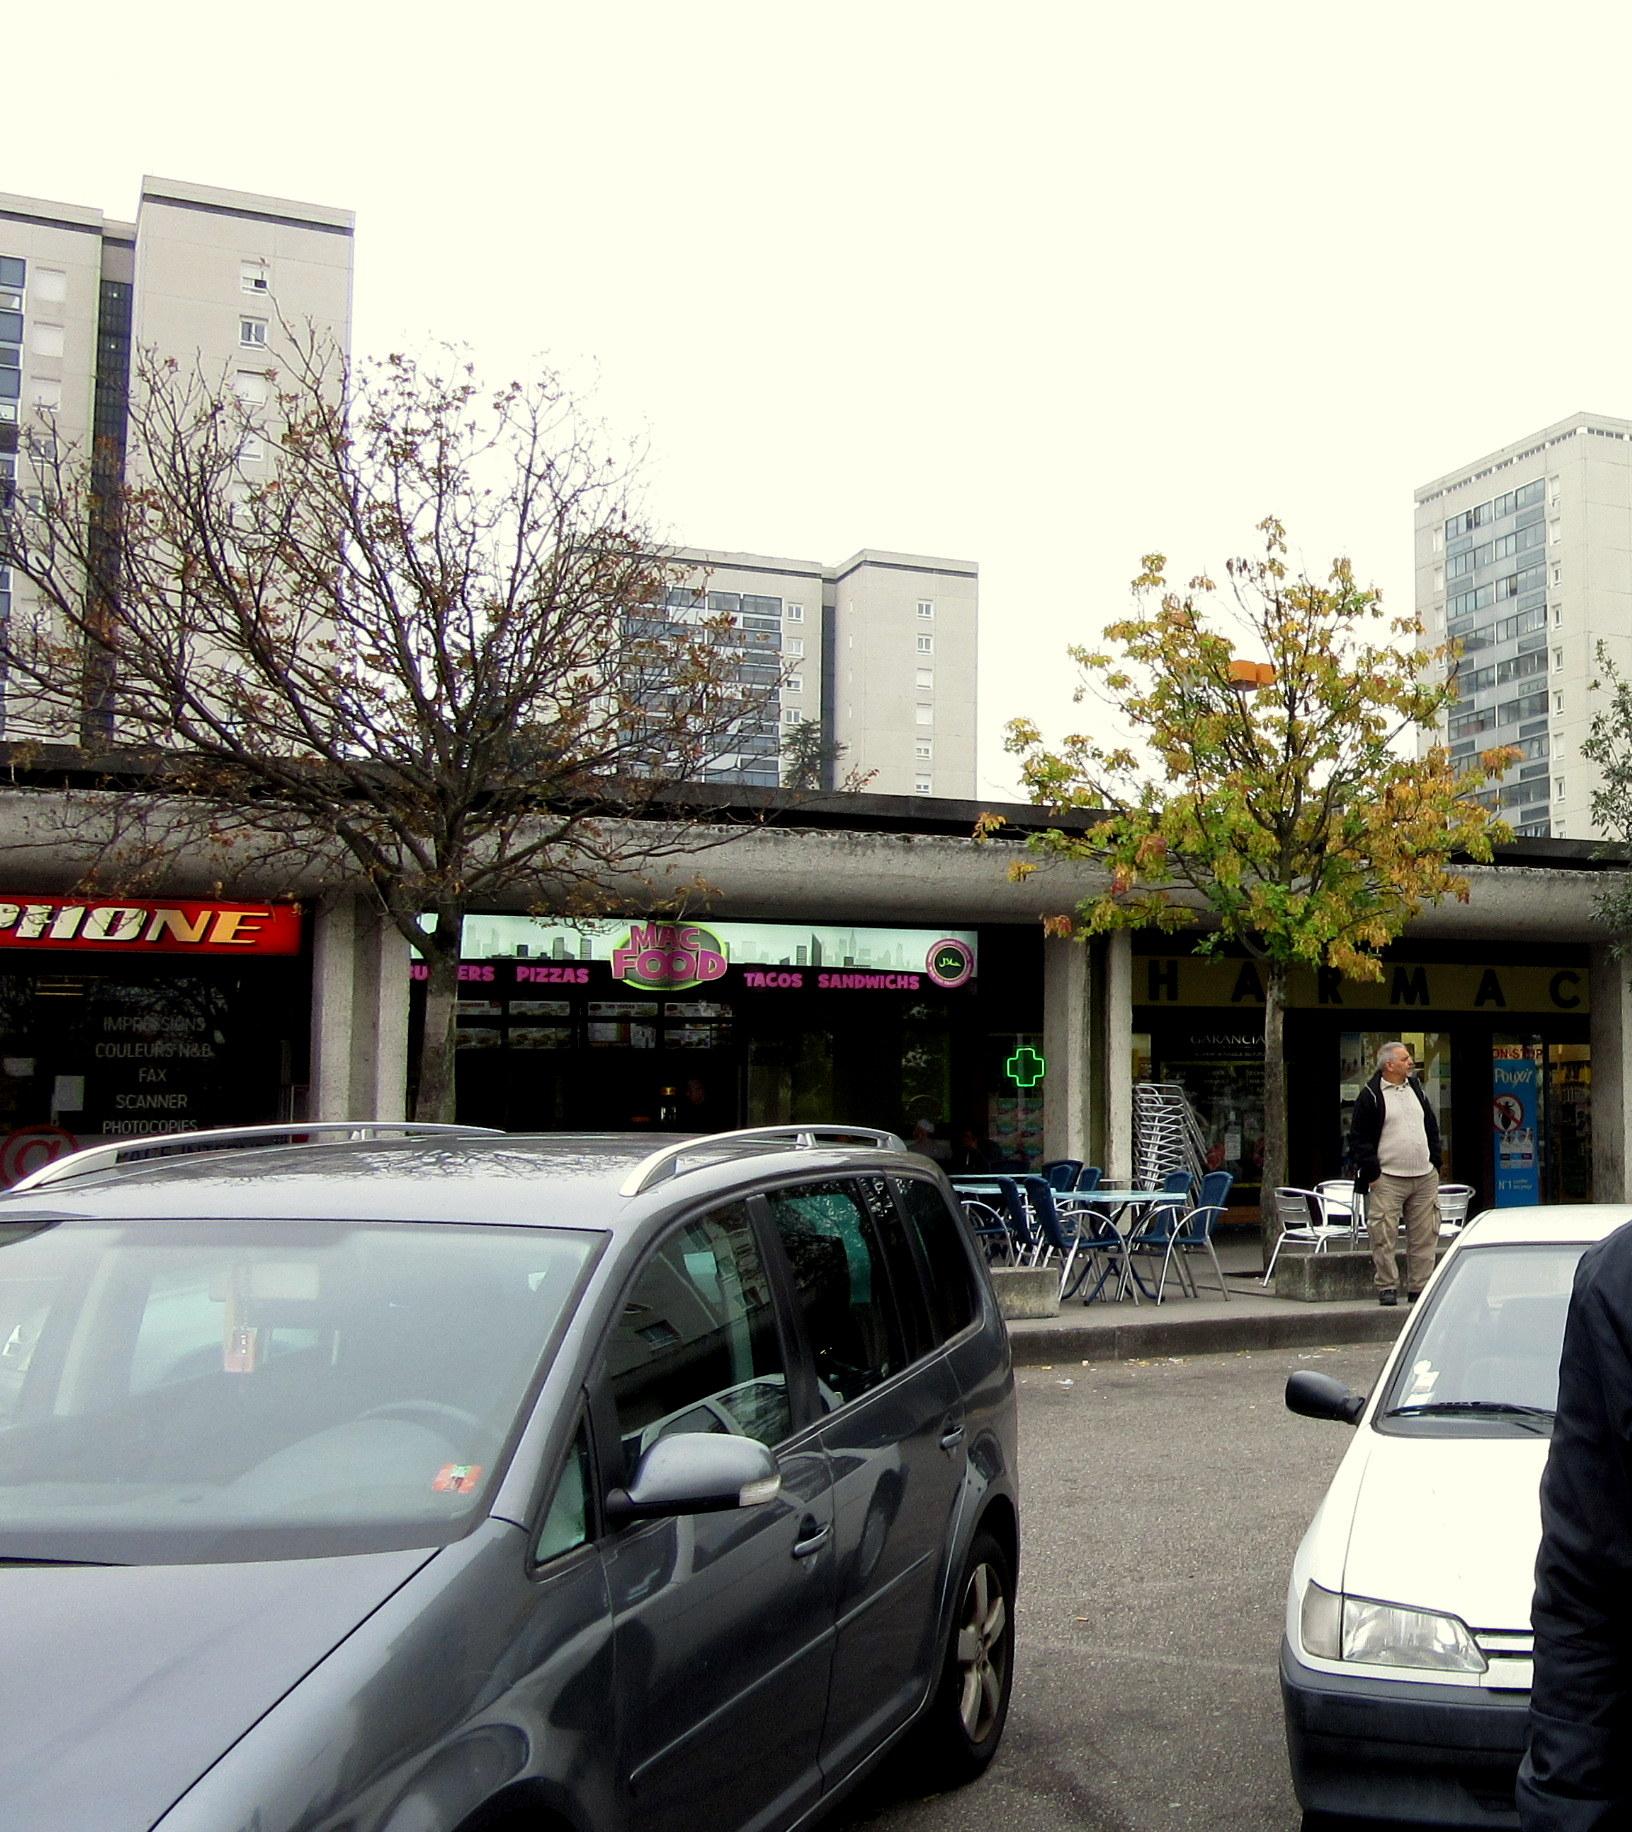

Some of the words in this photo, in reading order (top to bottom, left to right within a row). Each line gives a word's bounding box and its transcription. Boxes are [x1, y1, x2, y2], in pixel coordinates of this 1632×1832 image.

[630, 920, 701, 952] MAC
[612, 948, 728, 981] FOOD
[410, 964, 495, 982] UERS
[515, 966, 590, 984] PIZZAS
[743, 971, 803, 988] TACOS
[817, 972, 920, 991] SANDWICHS
[103, 1016, 206, 1032] IMPRESSIONS
[95, 1042, 174, 1059] COULEURS
[138, 1068, 167, 1083] FAX
[116, 1094, 188, 1110] SCANNER
[102, 1119, 198, 1135] PHOTOCOPIES
